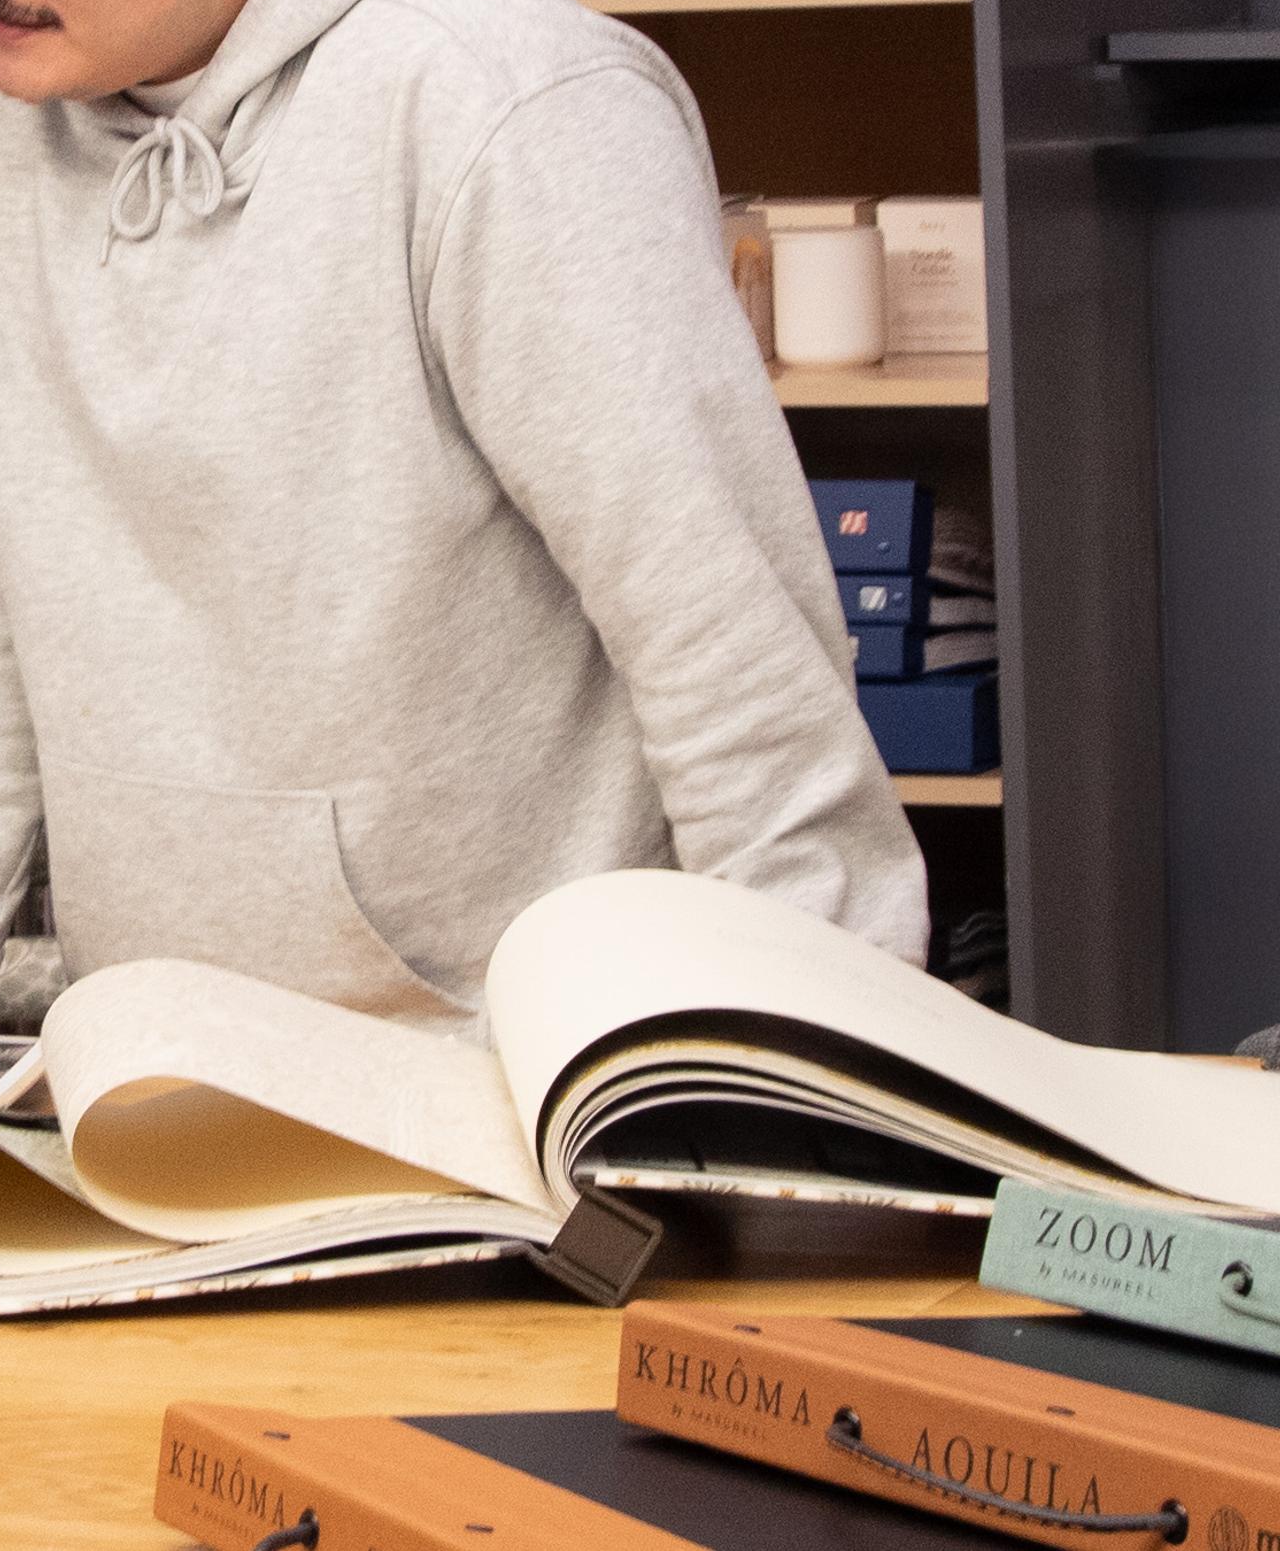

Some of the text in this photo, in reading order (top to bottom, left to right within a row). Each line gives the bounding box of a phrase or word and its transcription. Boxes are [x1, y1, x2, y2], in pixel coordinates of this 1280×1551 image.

[1035, 1205, 1177, 1273] ZOOM
[635, 1343, 1101, 1515] KHRÔMA AQUILA
[169, 1440, 285, 1527] KHRÔMA
